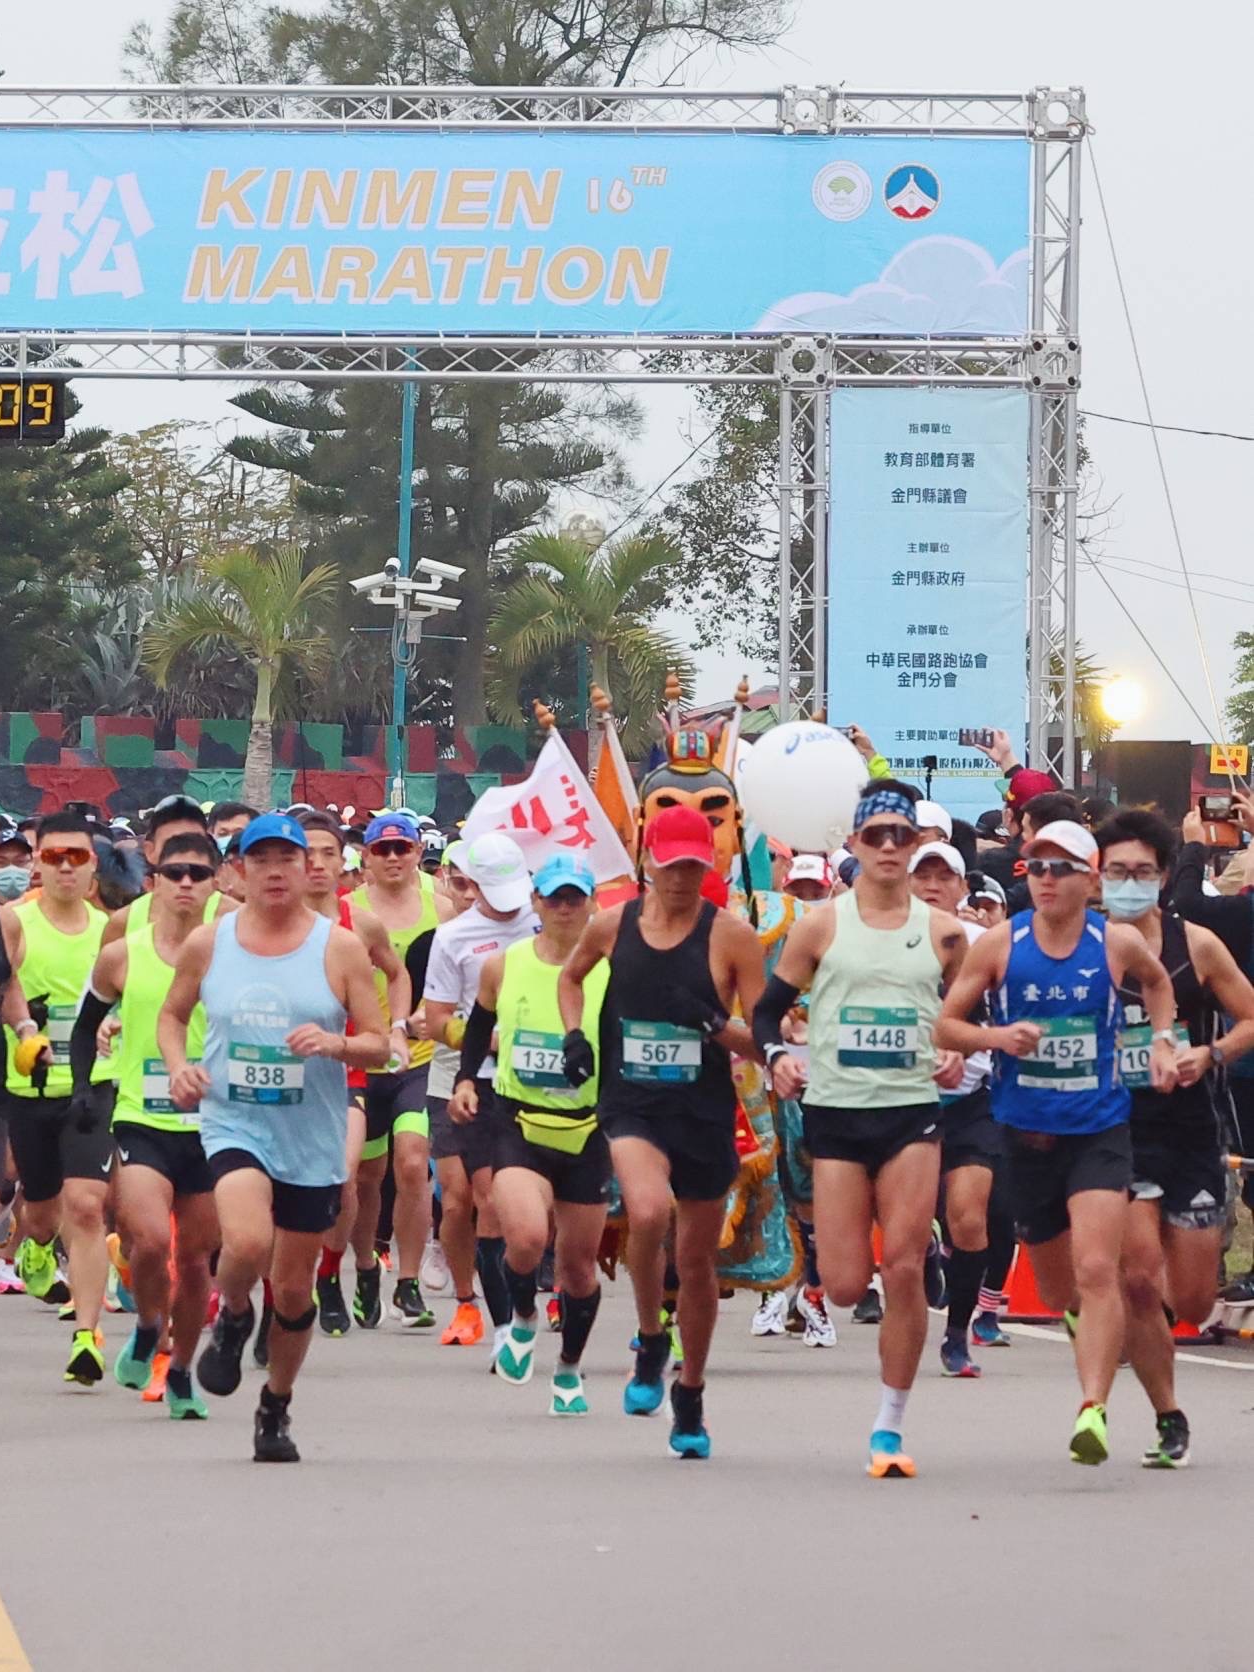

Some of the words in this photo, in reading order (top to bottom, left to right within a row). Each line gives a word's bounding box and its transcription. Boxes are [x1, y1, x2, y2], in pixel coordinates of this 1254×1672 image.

[195, 166, 565, 232] KINMEN
[182, 242, 672, 307] MARATHON
[908, 423, 952, 435] 指導單位
[884, 452, 976, 468] 教育部體育署
[891, 487, 967, 504] 金門縣議會
[907, 542, 950, 554] 主辦單位
[891, 570, 966, 587] 金門縣政府
[906, 624, 949, 636] 承辦單位
[866, 652, 988, 669] 中華民國路跑協會
[897, 671, 957, 688] 金門分會
[852, 1028, 906, 1048] 1448
[642, 1043, 681, 1063] 567
[1127, 1050, 1150, 1069] 10
[245, 1065, 285, 1086] 838
